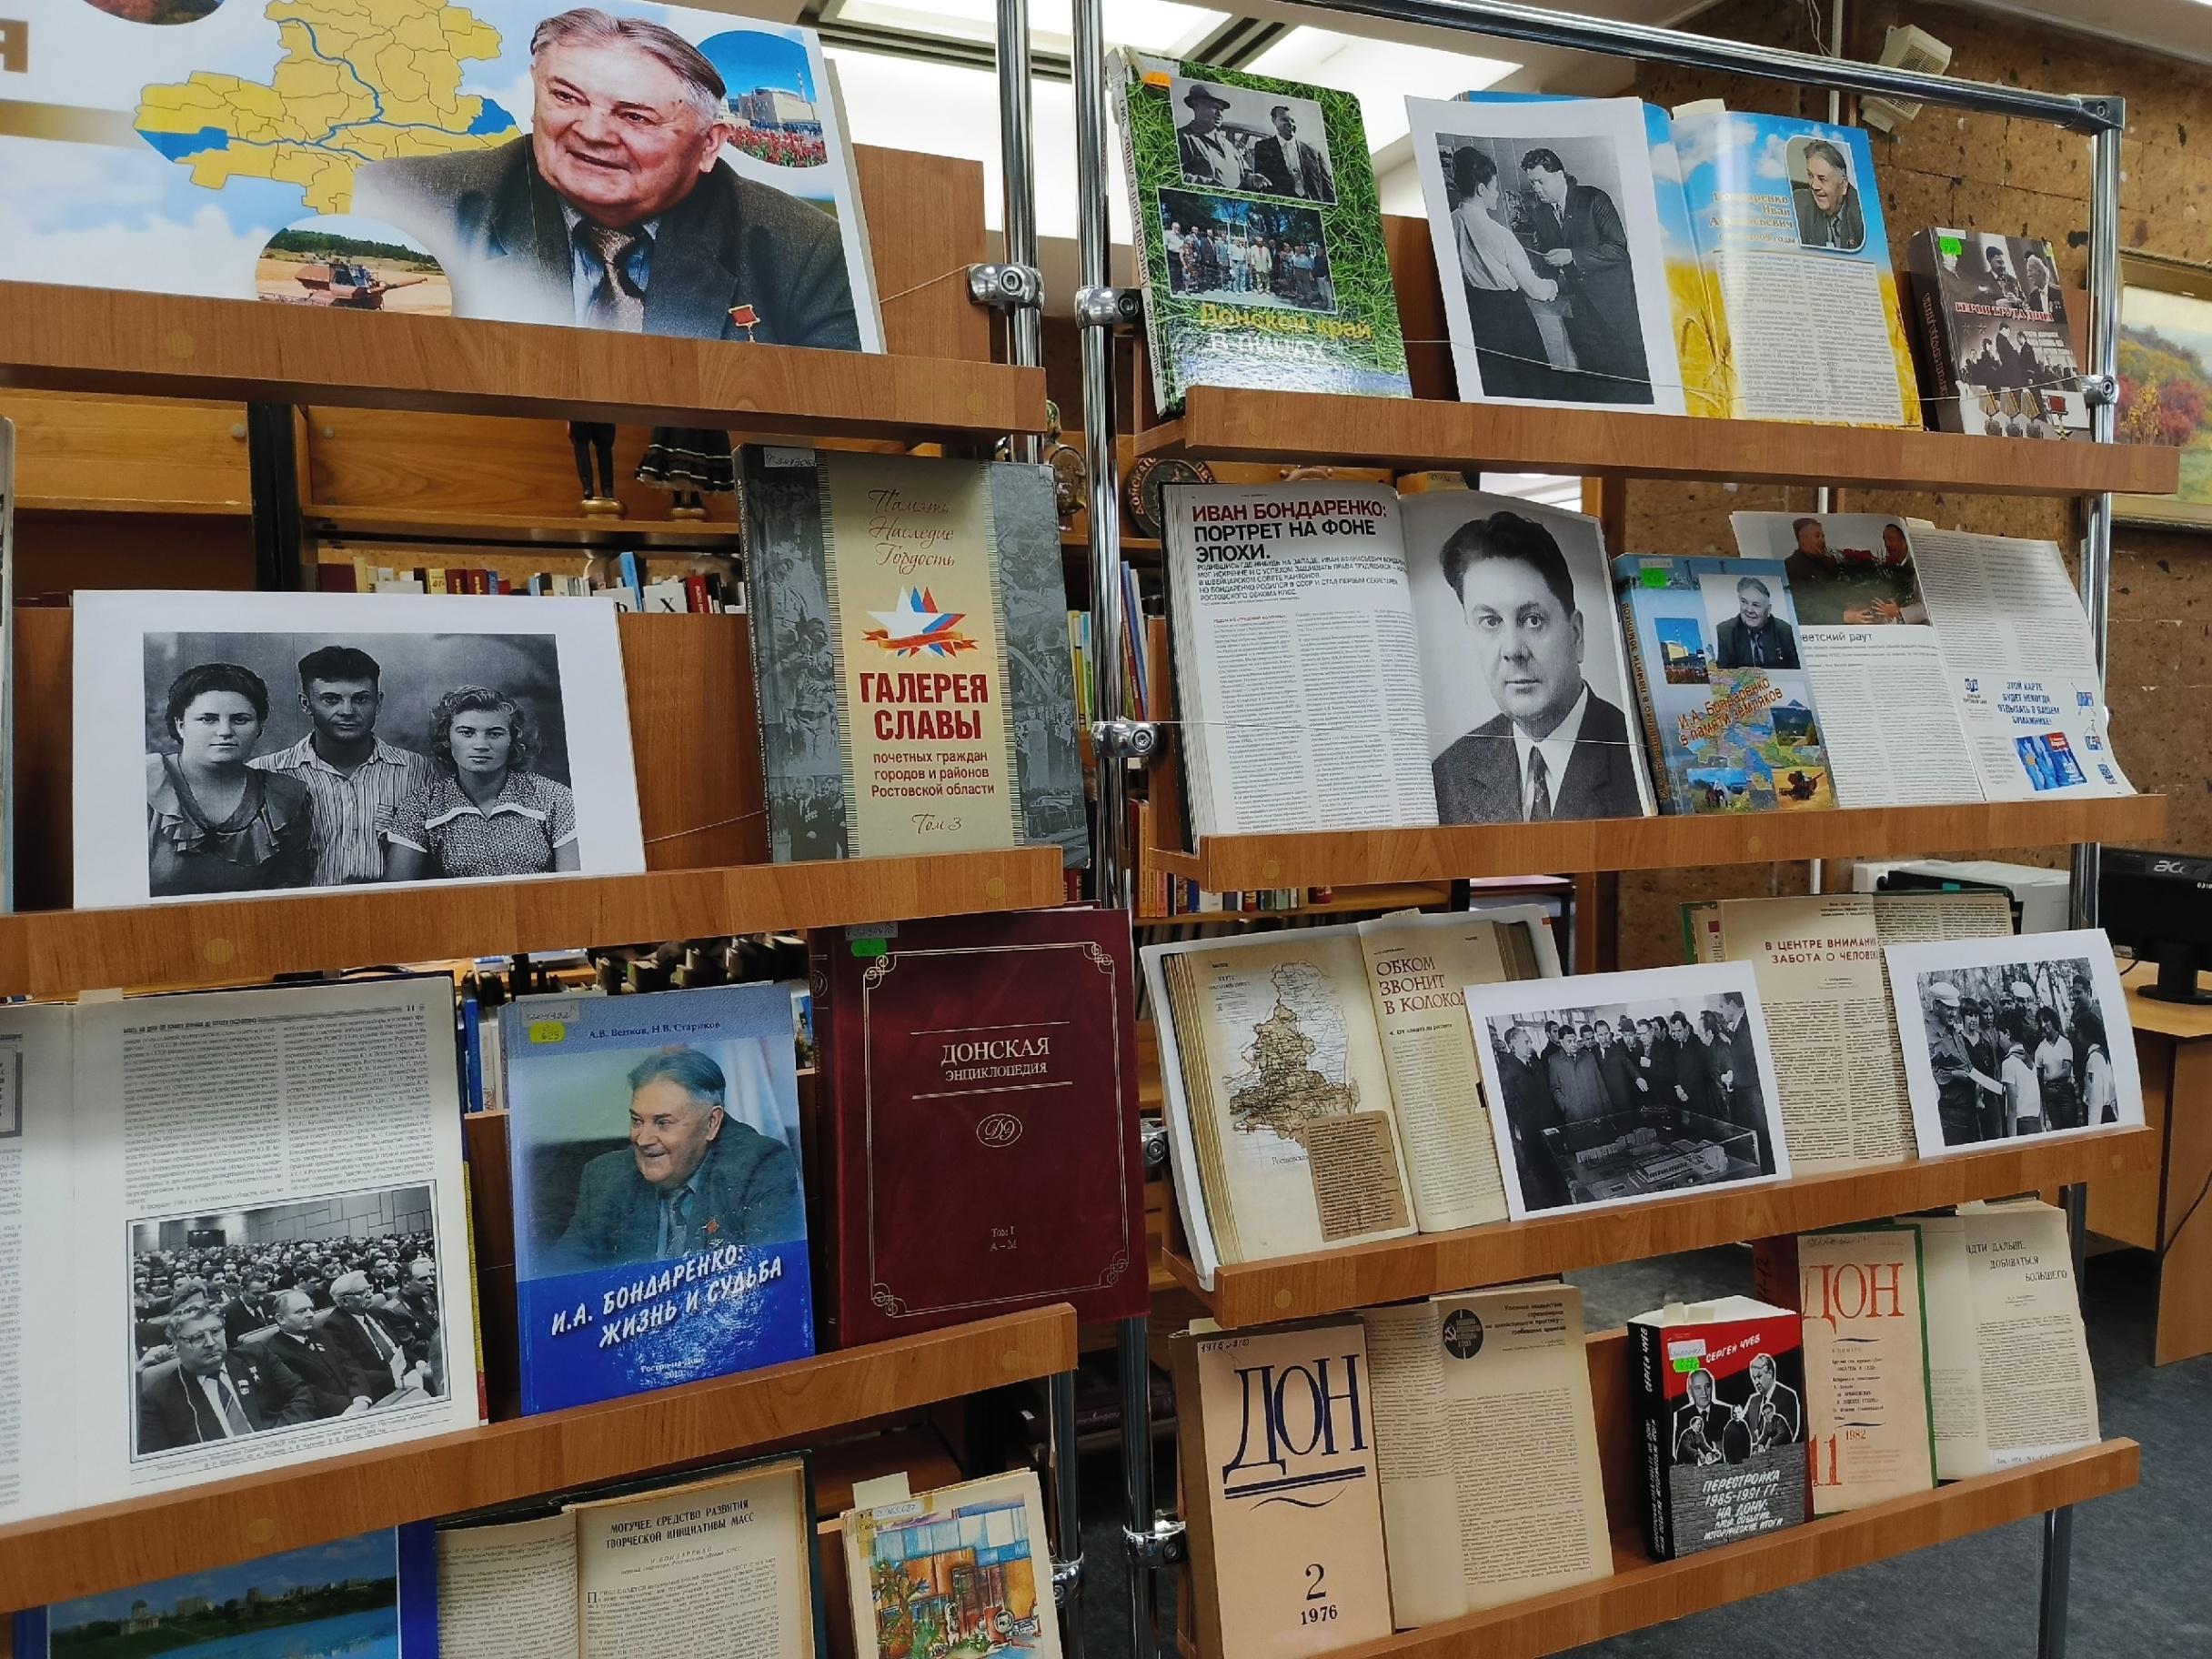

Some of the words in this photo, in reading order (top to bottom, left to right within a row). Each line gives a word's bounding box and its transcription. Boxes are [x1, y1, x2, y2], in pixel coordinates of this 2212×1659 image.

[1200, 303, 1310, 333] Донской
[1316, 319, 1373, 340] край
[1191, 505, 1248, 522] ИВАН
[1253, 499, 1387, 520] БОНДАРЕНКО:
[869, 517, 955, 548] Наследие
[1194, 522, 1283, 542] ПОРТРЕТ
[1290, 521, 1317, 538] НА
[1322, 518, 1376, 536] ФОНЕ
[874, 543, 955, 575] Гордость
[1196, 544, 1271, 563] ЭПОХИ.
[1849, 632, 1873, 644] раут
[860, 672, 989, 704] ГАЛЕРЕЯ
[2002, 693, 2022, 702] БУДЕТ
[2024, 682, 2043, 691] КАРТЕ
[1678, 709, 1704, 730] И.А.
[1704, 675, 1771, 718] Бондаренко
[873, 709, 982, 740] СЛАВЫ
[1680, 734, 1688, 746] в
[1690, 711, 1731, 740] памяти
[1734, 687, 1784, 721] земляков
[873, 752, 933, 764] почетных
[936, 752, 989, 766] граждан
[874, 769, 926, 782] городов
[929, 770, 937, 780] и
[940, 767, 990, 782] районов
[871, 782, 943, 799] Ростовской
[947, 782, 995, 797] области
[912, 812, 944, 834] Том
[949, 816, 961, 830] 3
[1765, 940, 1773, 951] В
[1778, 939, 1823, 952] ЦЕНТРЕ
[1376, 956, 1436, 976] ОБКОМ
[1772, 952, 1820, 964] ЗАБОТА
[1827, 951, 1835, 961] О
[1379, 974, 1445, 997] ЗВОНИТ
[1383, 1000, 1395, 1015] В
[940, 1037, 1050, 1068] ДОНСКАЯ
[945, 1061, 1048, 1081] ЭНЦИКЛОПЕДИЯ
[991, 1227, 1008, 1238] Том
[1966, 1242, 1987, 1255] ИДТИ
[1990, 1257, 2039, 1270] ДОБИВАТЬСЯ
[2026, 1271, 2067, 1282] БОЛЬШЕГО
[552, 1302, 592, 1335] И.А.
[604, 1244, 743, 1314] БОНДАРЕНКО:
[1802, 1263, 1905, 1334] ДОН
[599, 1300, 677, 1348] ЖИЗНЬ
[686, 1290, 699, 1312] И
[708, 1256, 781, 1302] СУДЬБА
[1706, 1343, 1737, 1363] СЕРГЕЙ
[1740, 1333, 1761, 1349] ЧУЕВ
[1222, 1354, 1368, 1484] ДОН
[1845, 1430, 1866, 1441] 1982
[1810, 1433, 1842, 1486] 11
[1703, 1470, 1780, 1493] ПЕРЕСТРОЙКА
[1705, 1487, 1760, 1507] 1985-1991
[611, 1520, 651, 1534] МОГУЧЕЕ
[657, 1510, 700, 1526] СРЕДСТВО
[706, 1499, 749, 1517] РАЗВИТИЯ
[1716, 1506, 1731, 1519] НА
[1736, 1499, 1768, 1516] ДОНУ:
[605, 1531, 661, 1549] ТВОРЧЕСКОЙ
[667, 1519, 726, 1540] ИНИЦИАТИВЫ
[730, 1512, 754, 1526] МАСС
[1305, 1563, 1327, 1601] 2
[1301, 1604, 1338, 1625] 1976
